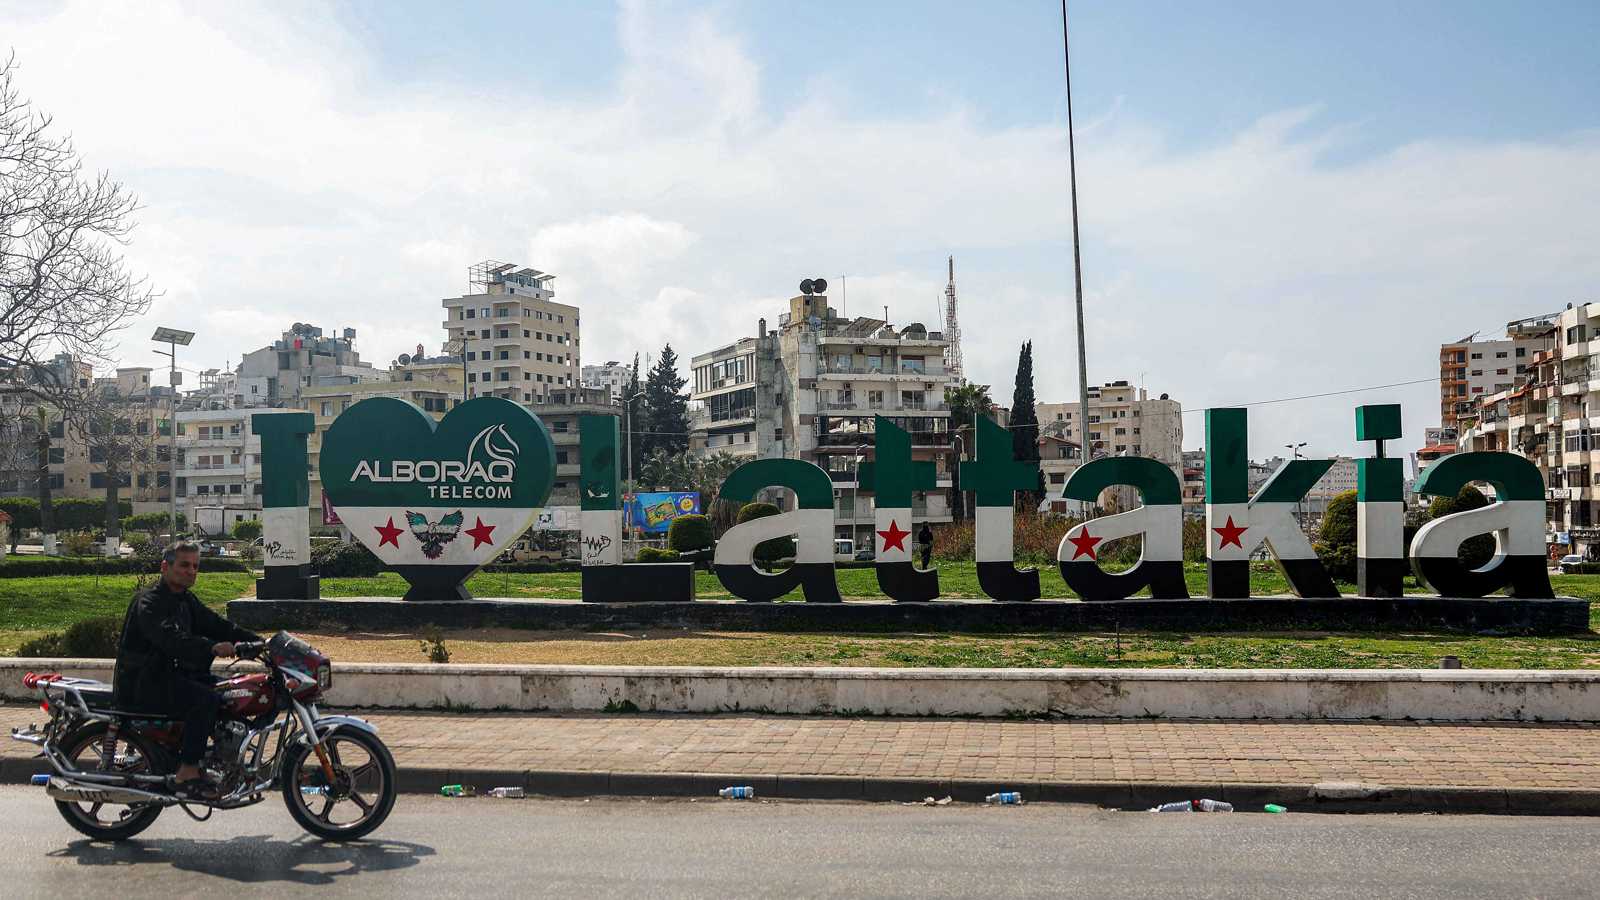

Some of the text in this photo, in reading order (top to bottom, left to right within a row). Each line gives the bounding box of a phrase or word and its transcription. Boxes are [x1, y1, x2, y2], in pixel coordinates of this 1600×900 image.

[350, 460, 514, 483] ALBORAQ
[252, 403, 1556, 603] I Lattakia
[427, 485, 512, 499] TELECOM
